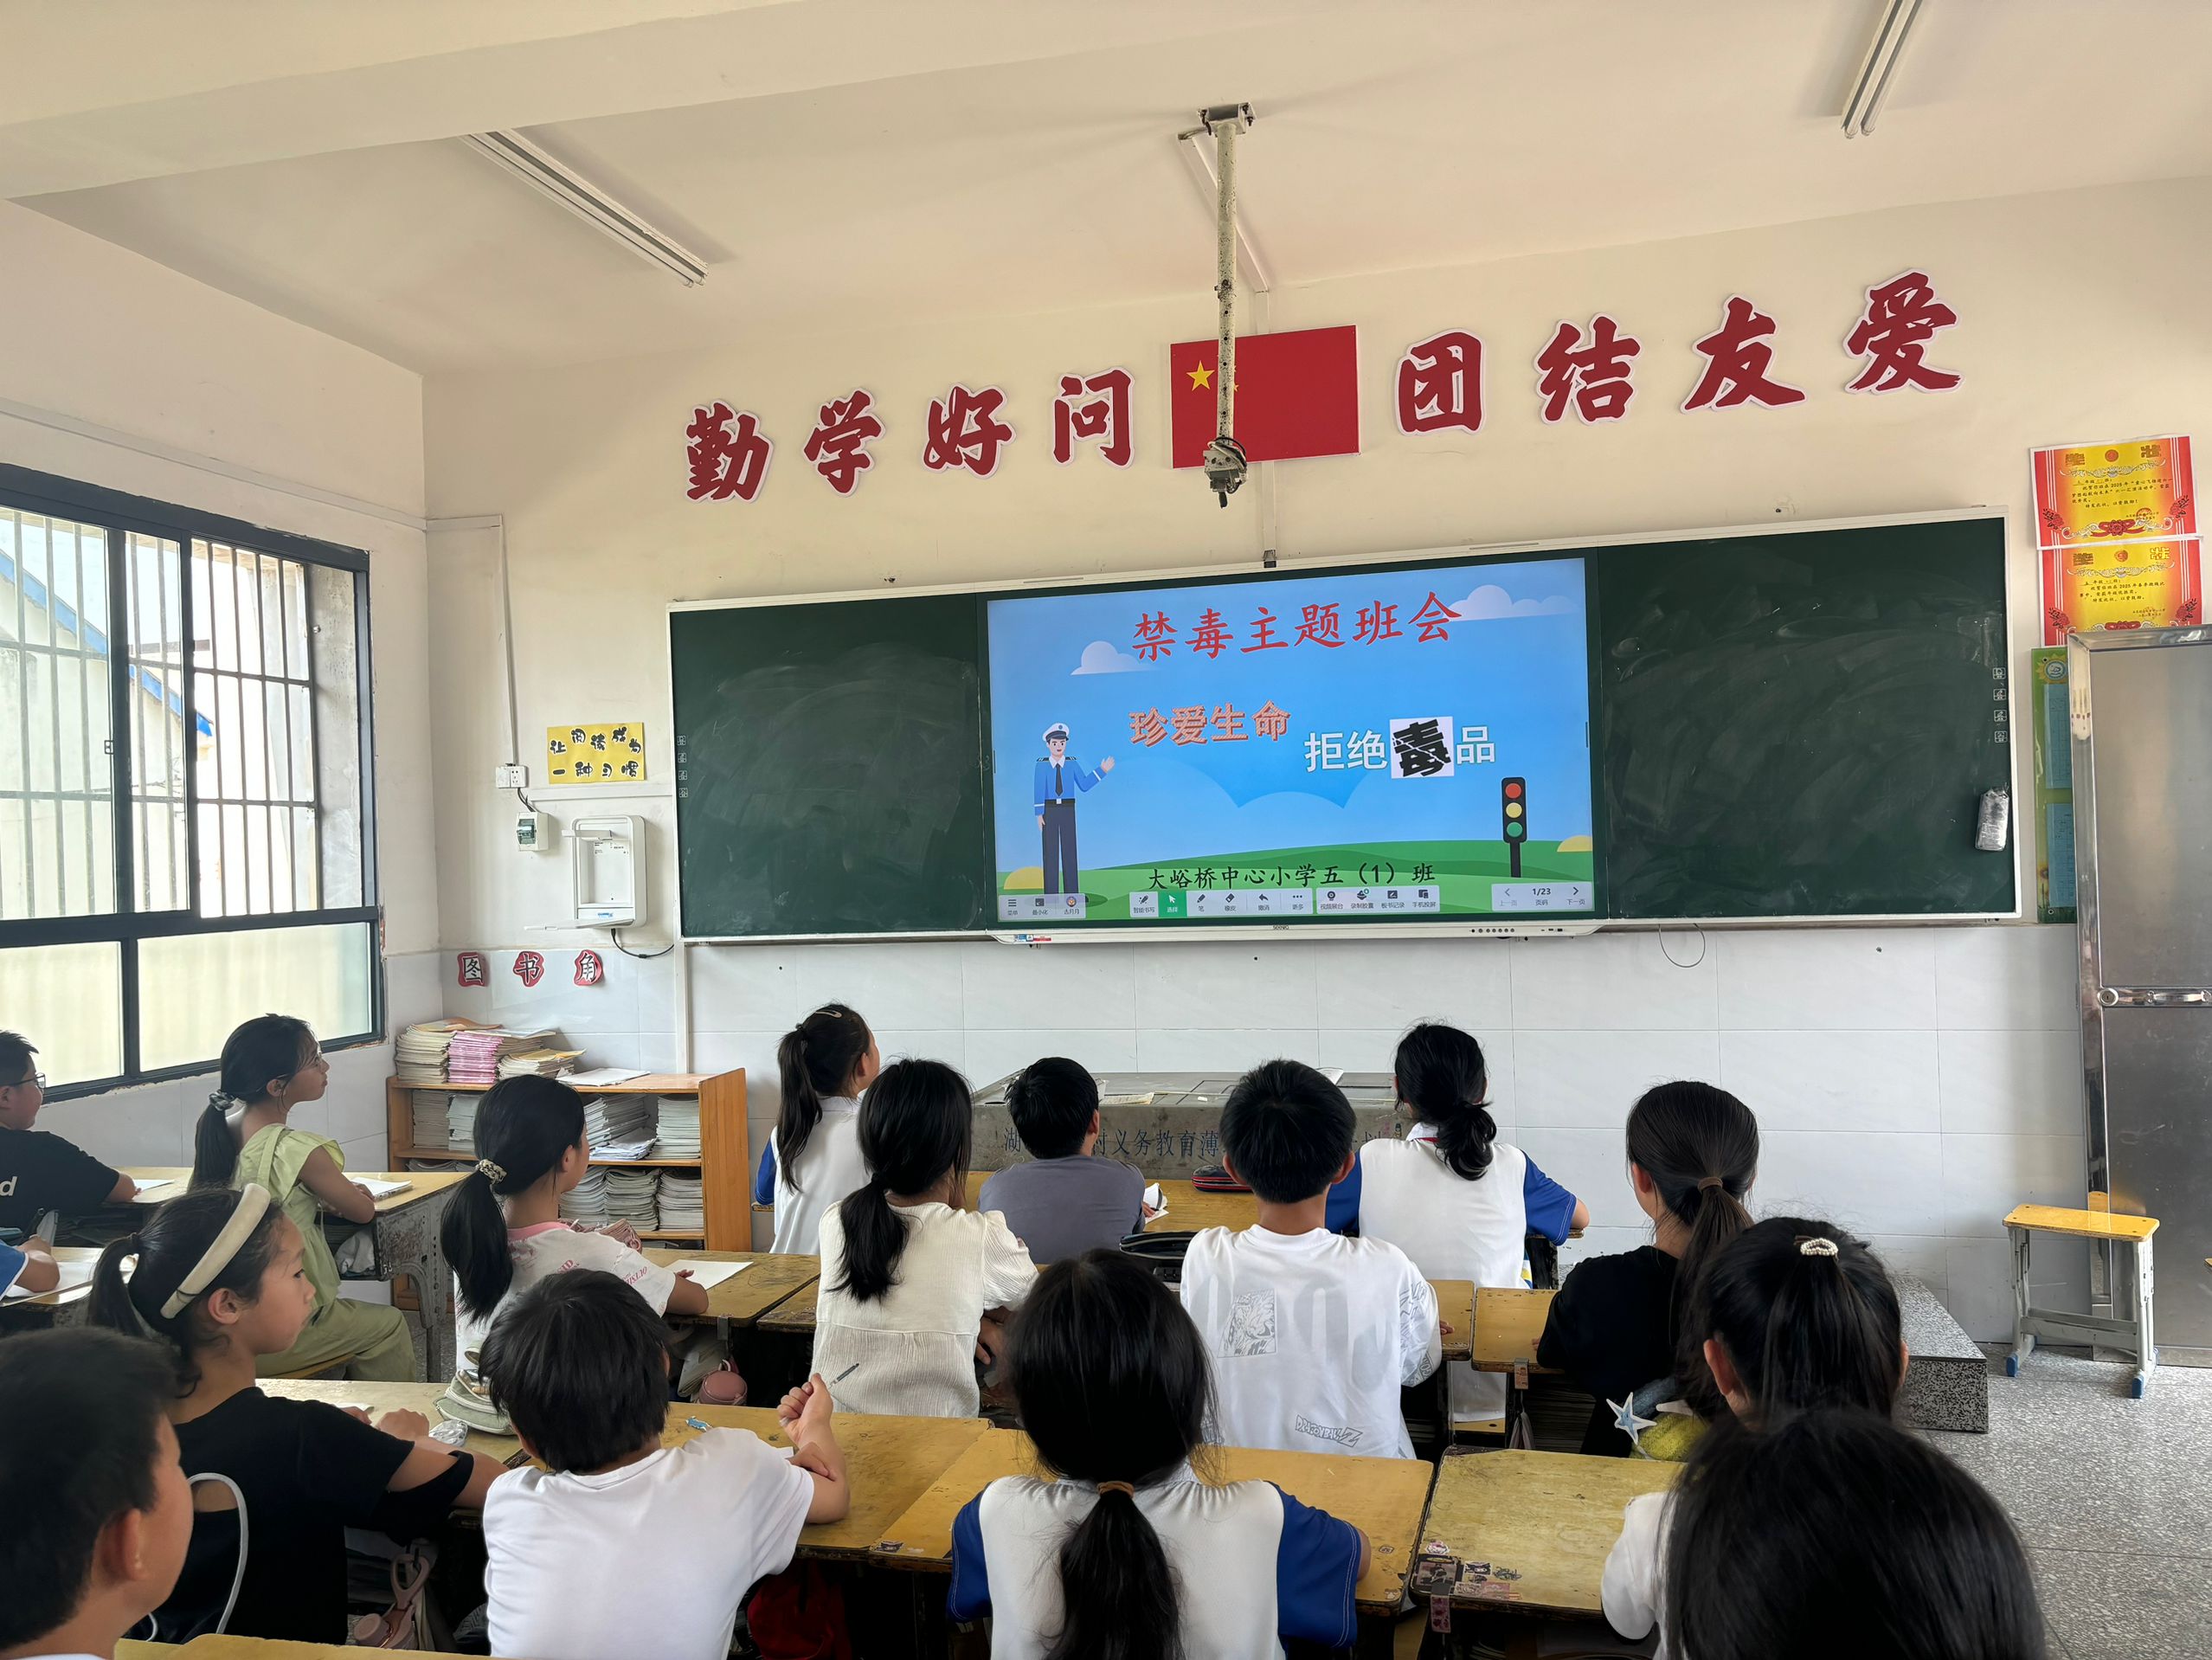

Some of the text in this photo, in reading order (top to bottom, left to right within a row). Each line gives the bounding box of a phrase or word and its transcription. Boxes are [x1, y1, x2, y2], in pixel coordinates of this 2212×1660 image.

[685, 270, 1962, 502] 勤学好问 团结友爱
[1131, 591, 1463, 661] 禁毒主题班会
[1128, 699, 1292, 748] 珍爱生命
[1304, 718, 1496, 778] 拒绝毒品
[1532, 888, 1552, 897] 1/23
[462, 952, 599, 986] 图书角
